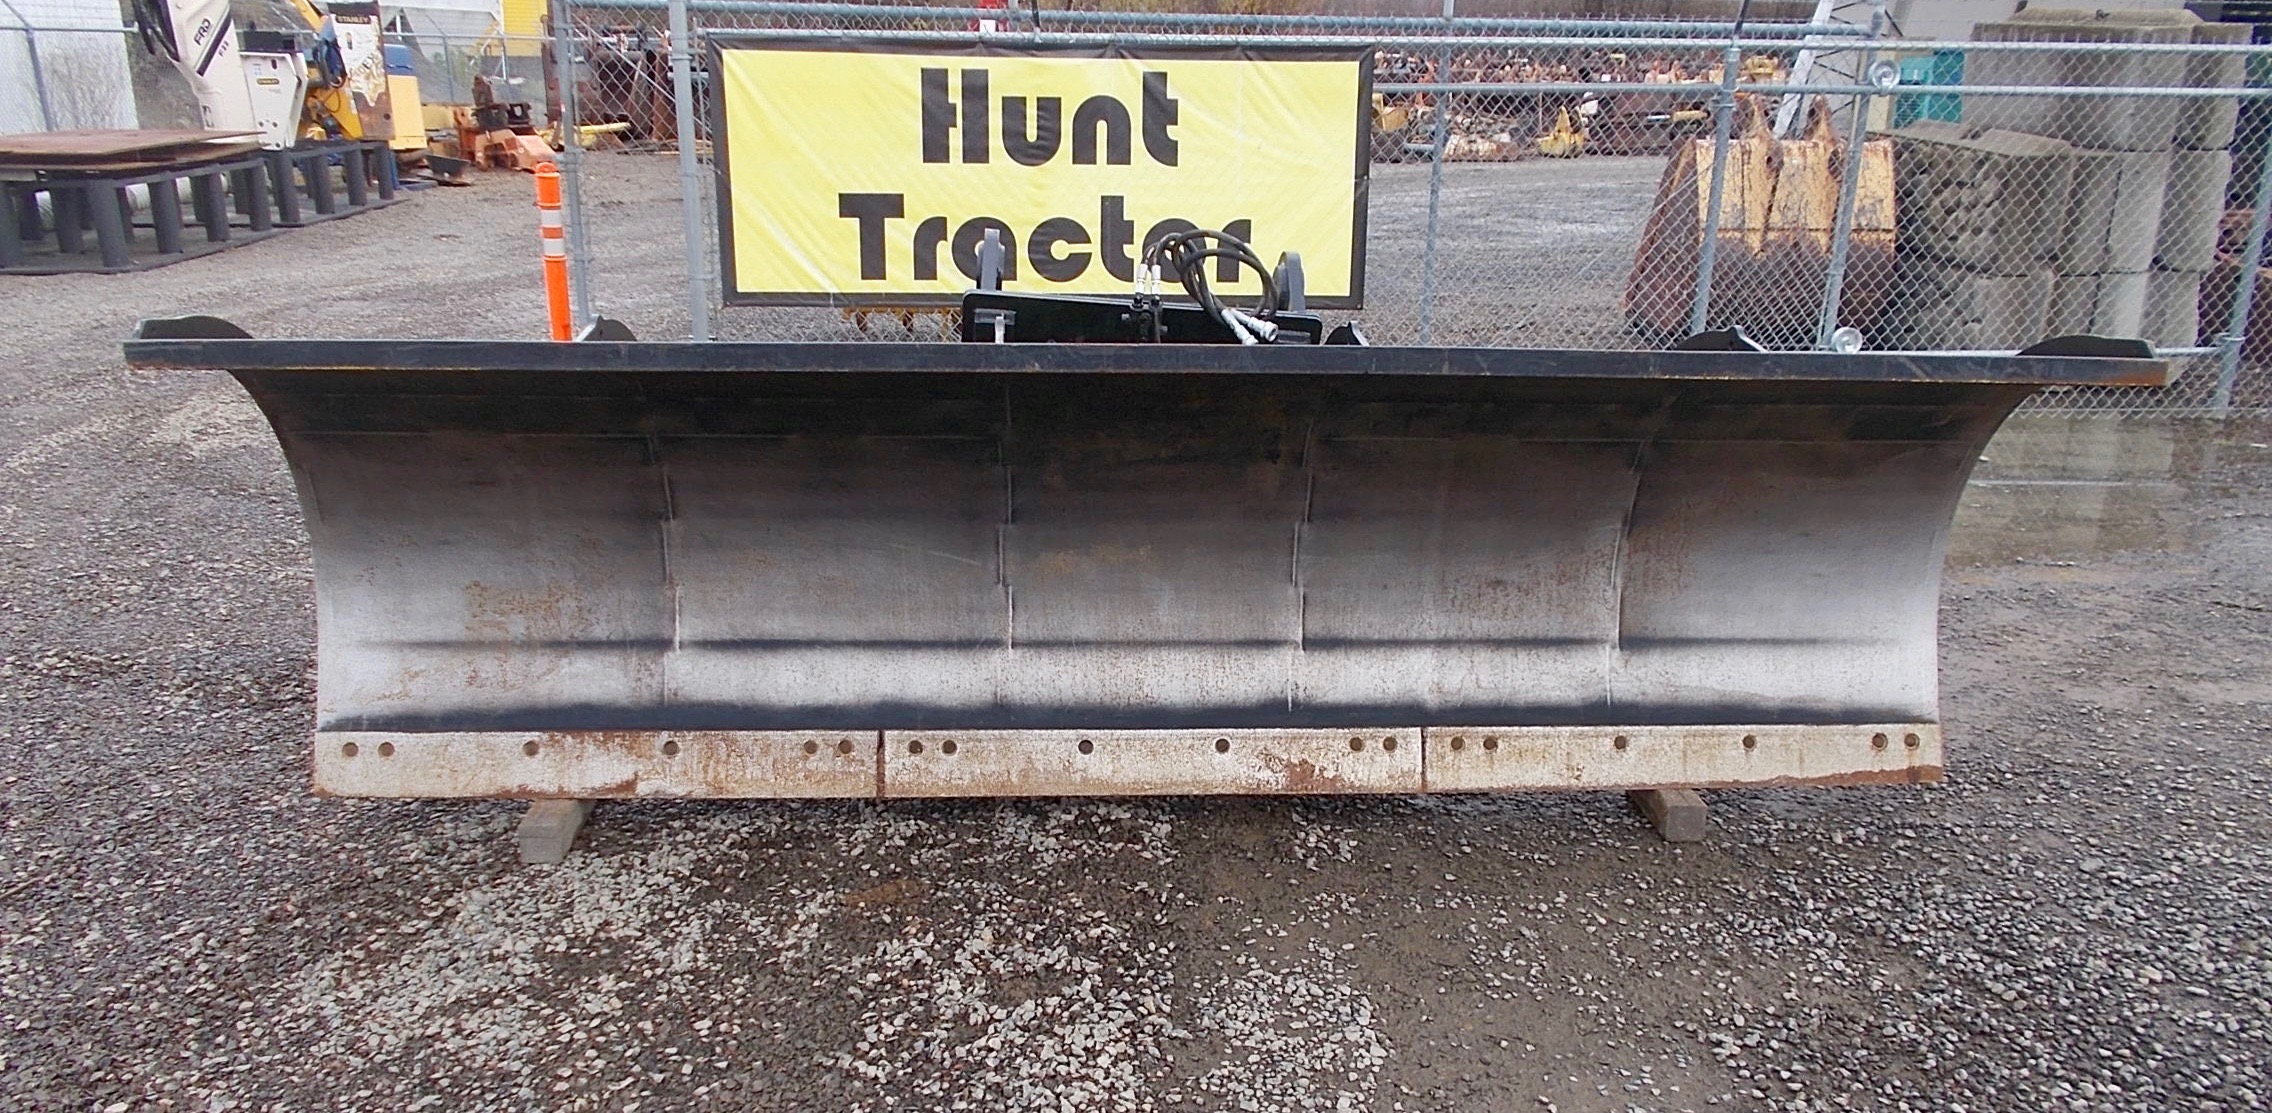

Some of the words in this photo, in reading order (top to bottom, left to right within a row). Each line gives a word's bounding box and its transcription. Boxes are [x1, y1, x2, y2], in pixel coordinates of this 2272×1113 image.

[194, 18, 211, 46] FRD
[921, 68, 1178, 166] Hunt
[838, 192, 1252, 282] Tractor
